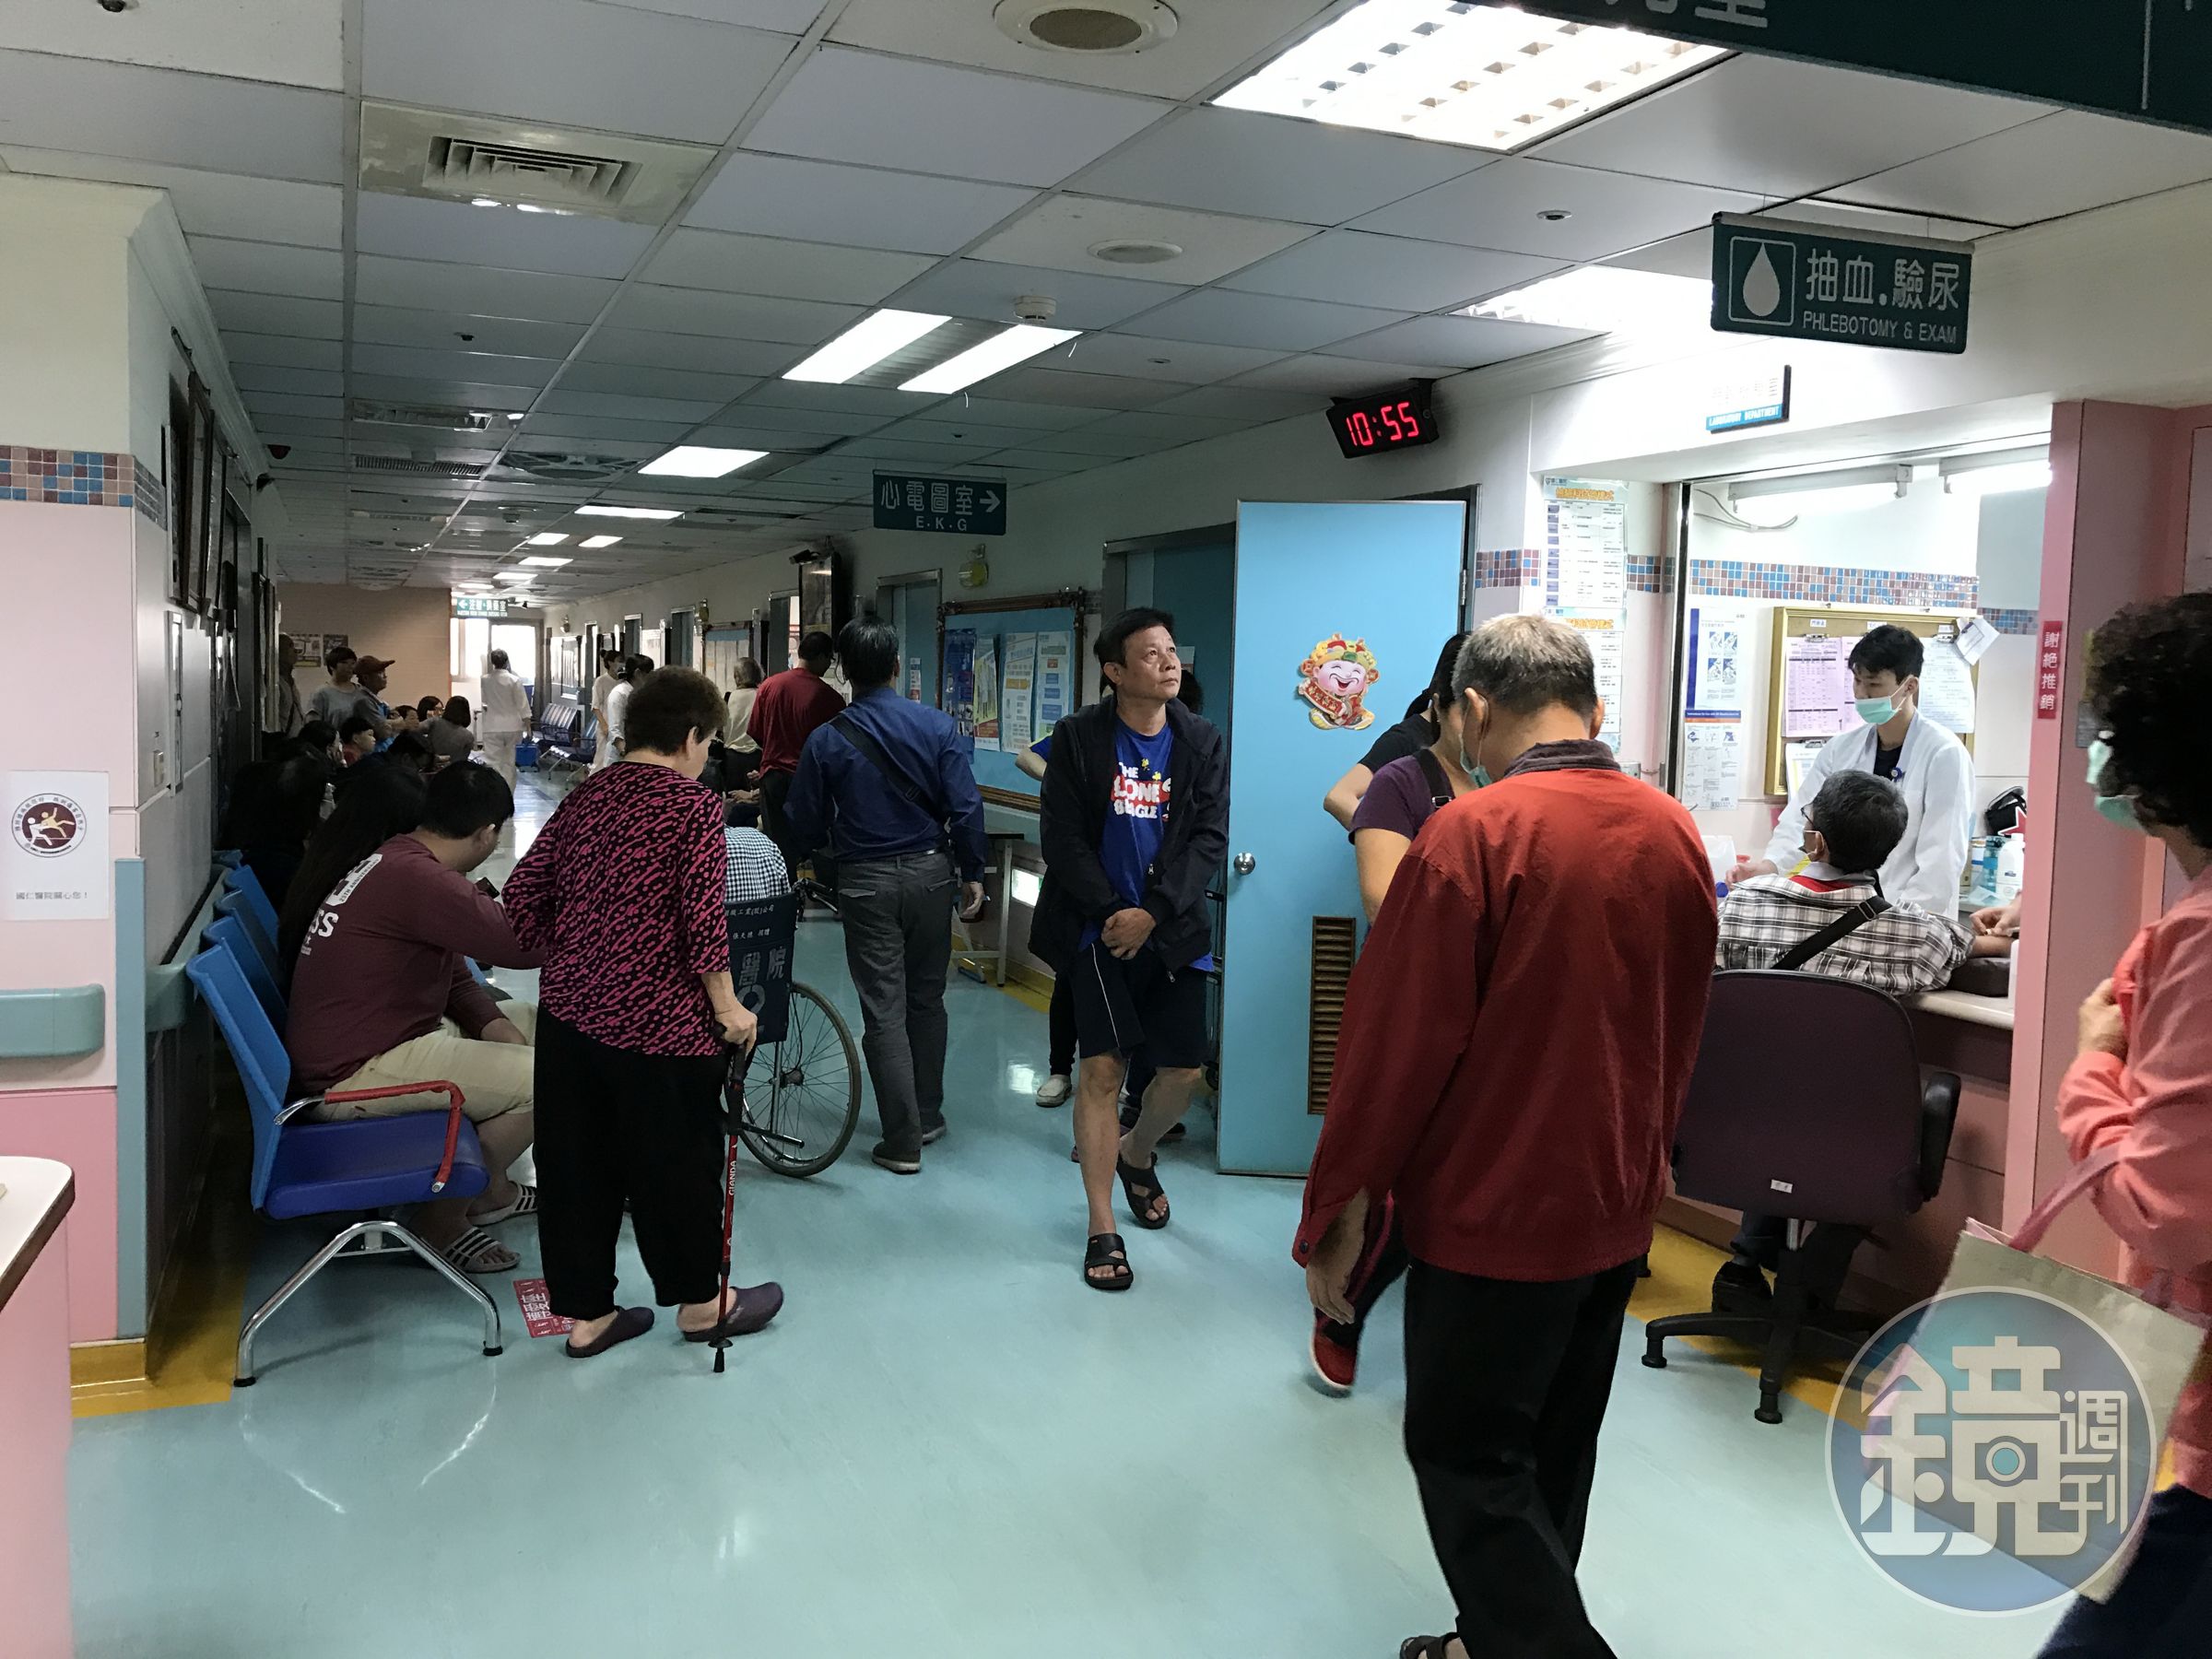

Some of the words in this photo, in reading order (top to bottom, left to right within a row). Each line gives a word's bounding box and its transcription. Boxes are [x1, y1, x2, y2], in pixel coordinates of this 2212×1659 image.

[1803, 311, 1898, 339] PHLEBOTOMY
[1903, 322, 1913, 339] &
[1919, 324, 1957, 345] EXAM
[1346, 402, 1419, 447] 10:55
[881, 479, 973, 515] 心電圖室
